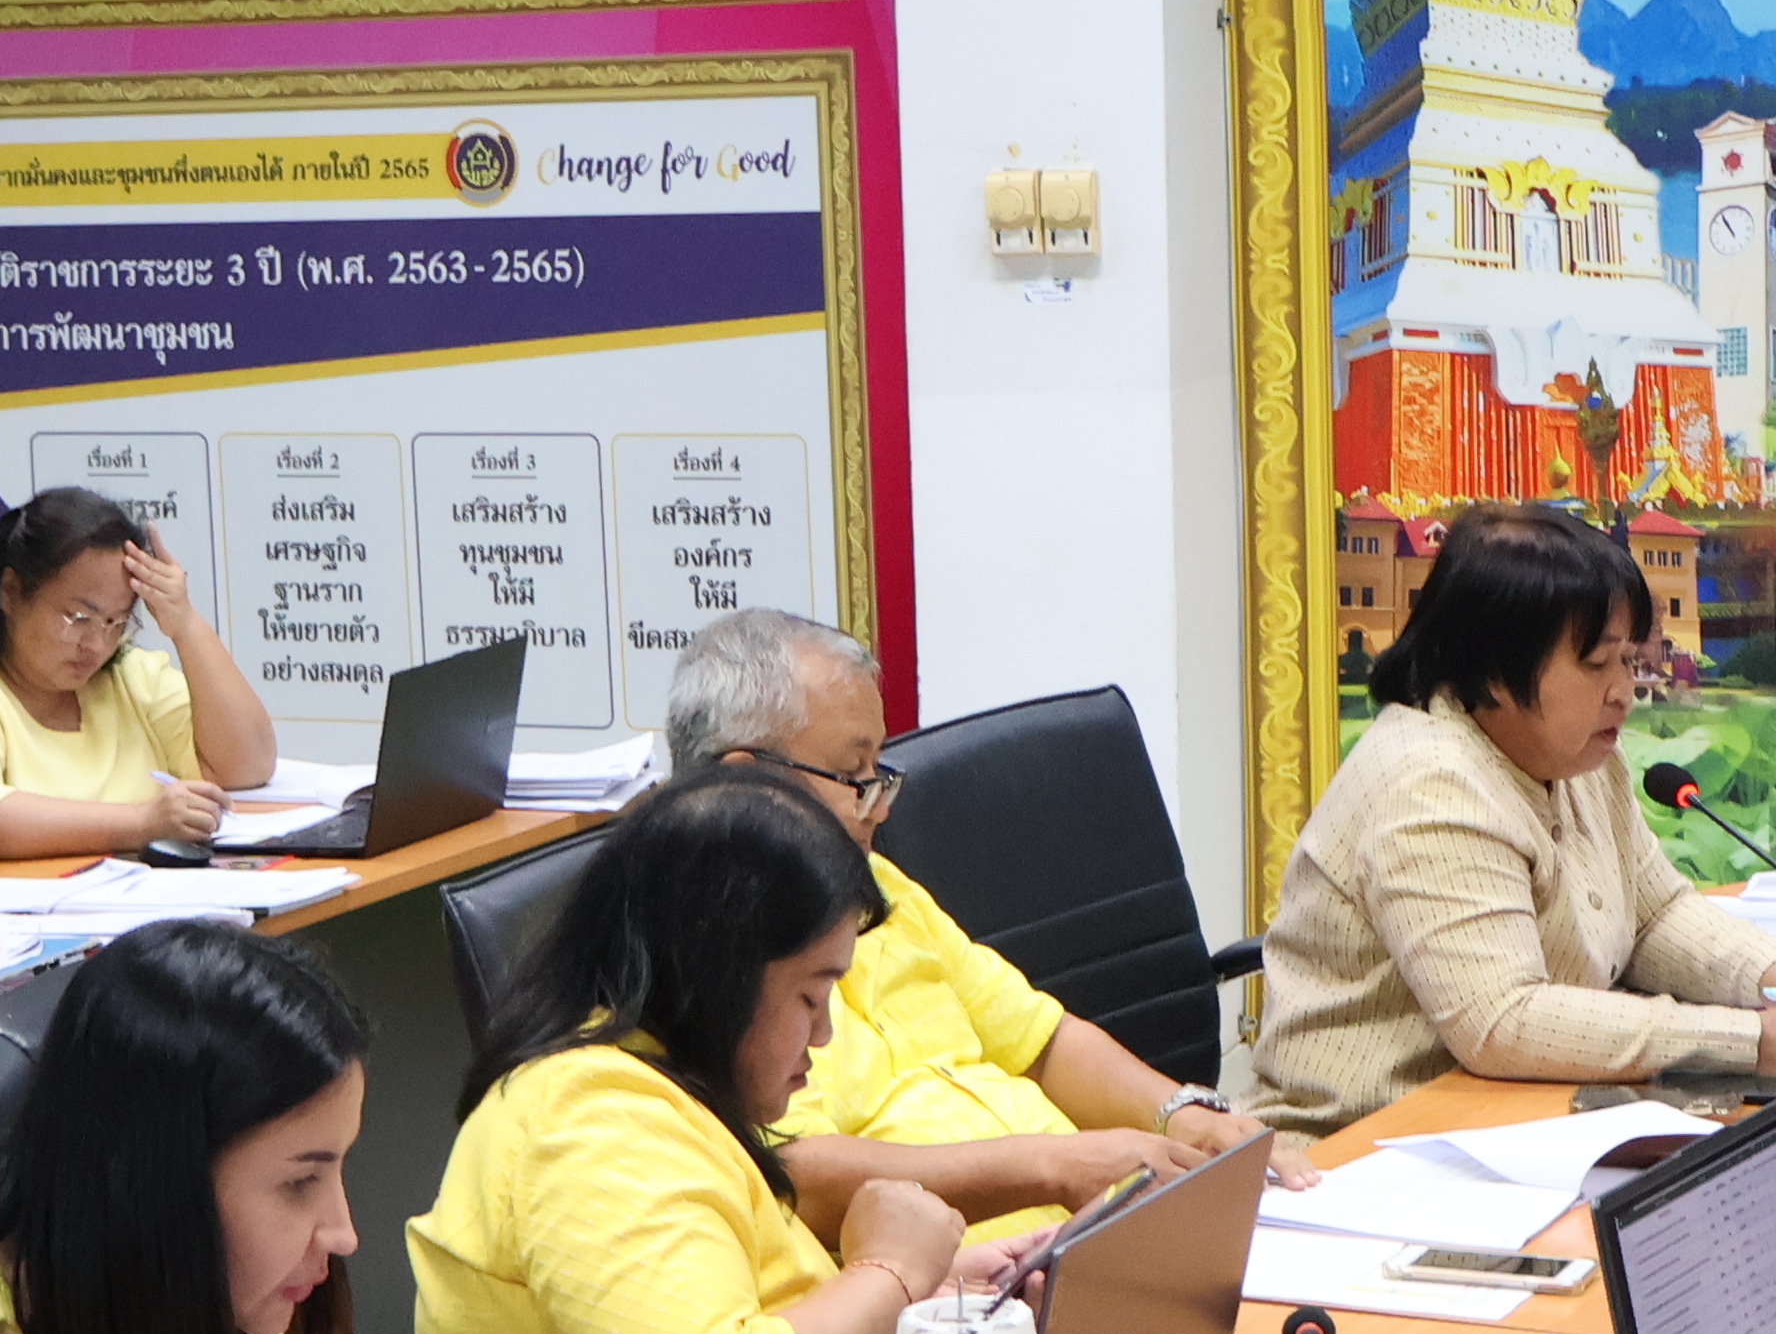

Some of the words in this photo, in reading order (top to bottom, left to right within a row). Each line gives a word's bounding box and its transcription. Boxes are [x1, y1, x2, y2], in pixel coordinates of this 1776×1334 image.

[291, 149, 370, 182] ภายในปี
[380, 157, 430, 181] 2565
[537, 143, 653, 194] Change
[661, 139, 709, 195] for
[716, 138, 797, 182] Good
[226, 255, 246, 287] 3
[257, 247, 284, 287] ปี
[297, 251, 374, 291] (พ.ศ.
[87, 445, 133, 469] เรื่องที่
[139, 452, 148, 468] 1
[276, 445, 324, 470] เรื่องที่
[329, 453, 341, 469] 2
[471, 446, 520, 471] เรื่องที่
[526, 454, 537, 471] 3
[673, 446, 724, 472] เรื่องที่
[729, 455, 742, 473] 4
[272, 493, 356, 521] ส่งเสริม
[452, 493, 568, 524] เสริมสร้าง
[651, 495, 773, 527] เสริมสร้าง
[265, 534, 367, 571] เศรษฐกิจ
[459, 541, 564, 576] ทุนชุมชน
[673, 537, 754, 568] องค์กร
[273, 579, 363, 610] ฐานราก
[488, 572, 536, 607] ให้มี
[688, 574, 738, 610] ให้มี
[257, 607, 380, 644] ให้ขยายตัว
[262, 654, 384, 695] อย่างสมดุล
